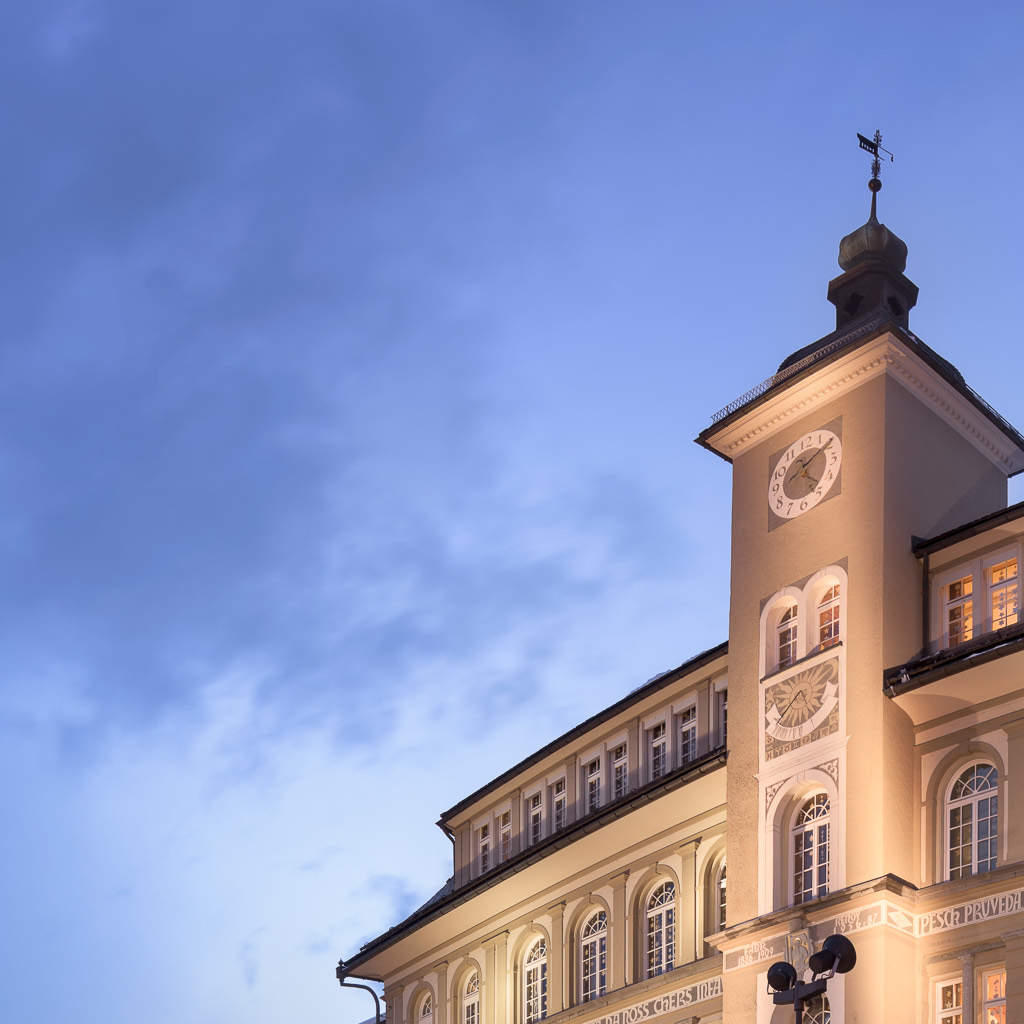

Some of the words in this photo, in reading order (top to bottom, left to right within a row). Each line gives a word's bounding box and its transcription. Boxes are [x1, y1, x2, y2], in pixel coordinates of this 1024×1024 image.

[800, 436, 812, 451] 12
[785, 449, 795, 462] 11
[774, 466, 786, 481] 10
[825, 469, 833, 481] 4
[772, 484, 779, 496] 9
[776, 496, 783, 510] 8
[787, 502, 794, 515] 7
[800, 497, 808, 511] 6
